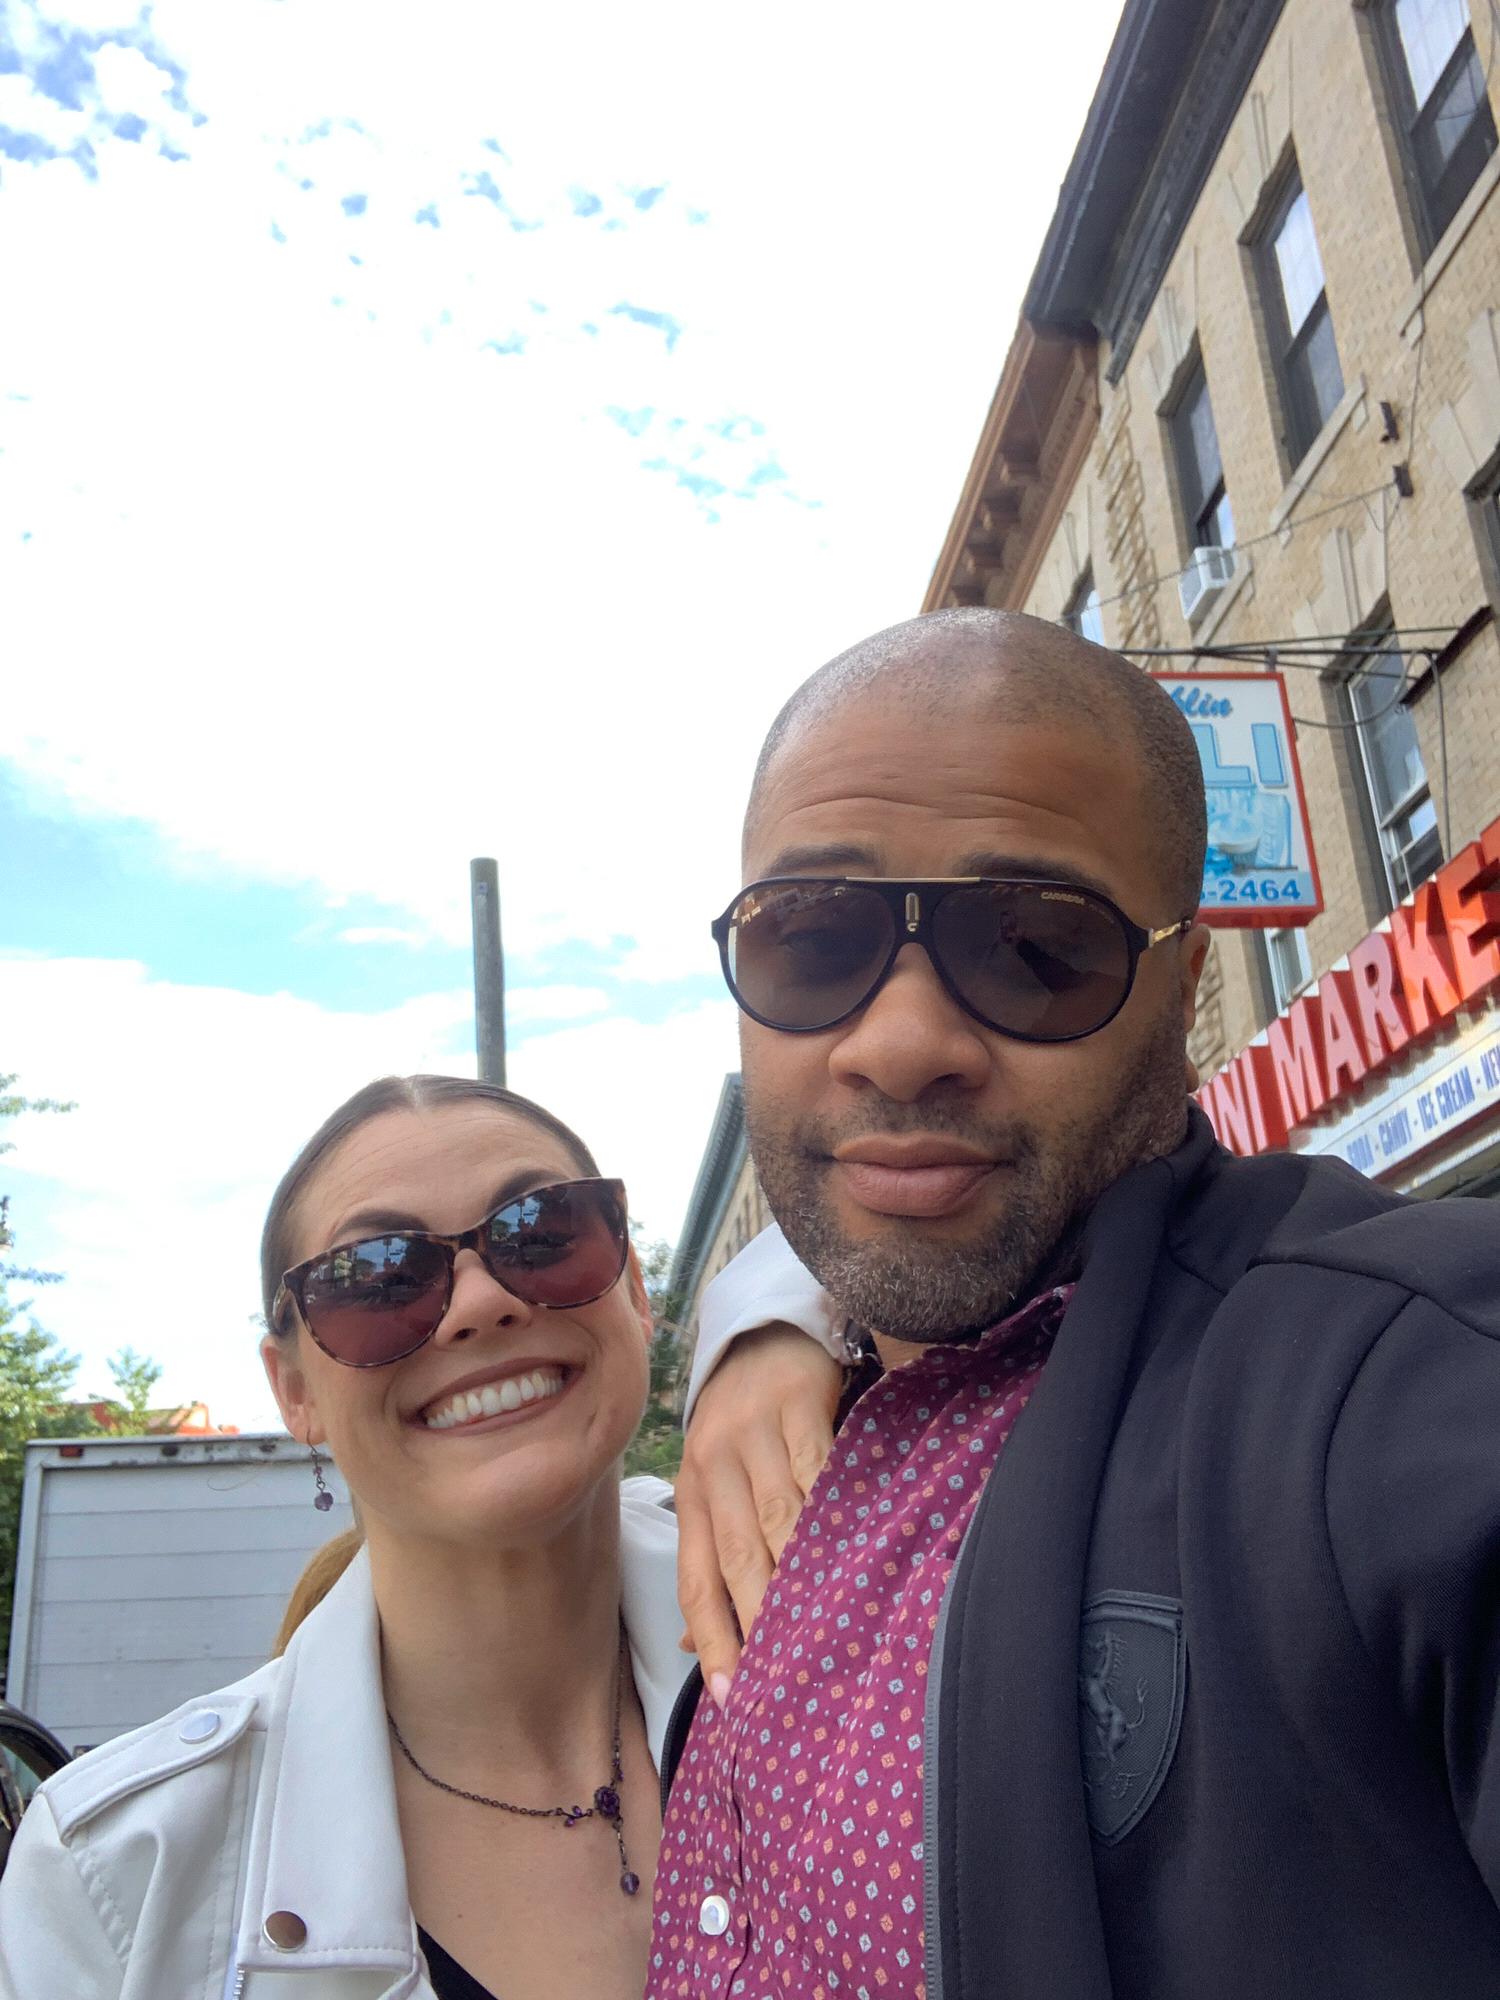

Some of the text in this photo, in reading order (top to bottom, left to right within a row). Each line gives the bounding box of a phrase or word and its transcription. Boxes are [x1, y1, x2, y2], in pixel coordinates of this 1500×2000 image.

[1267, 815, 1500, 1131] MARKE
[1417, 1091, 1438, 1132] ICE
[1435, 1065, 1476, 1120] CREAM
